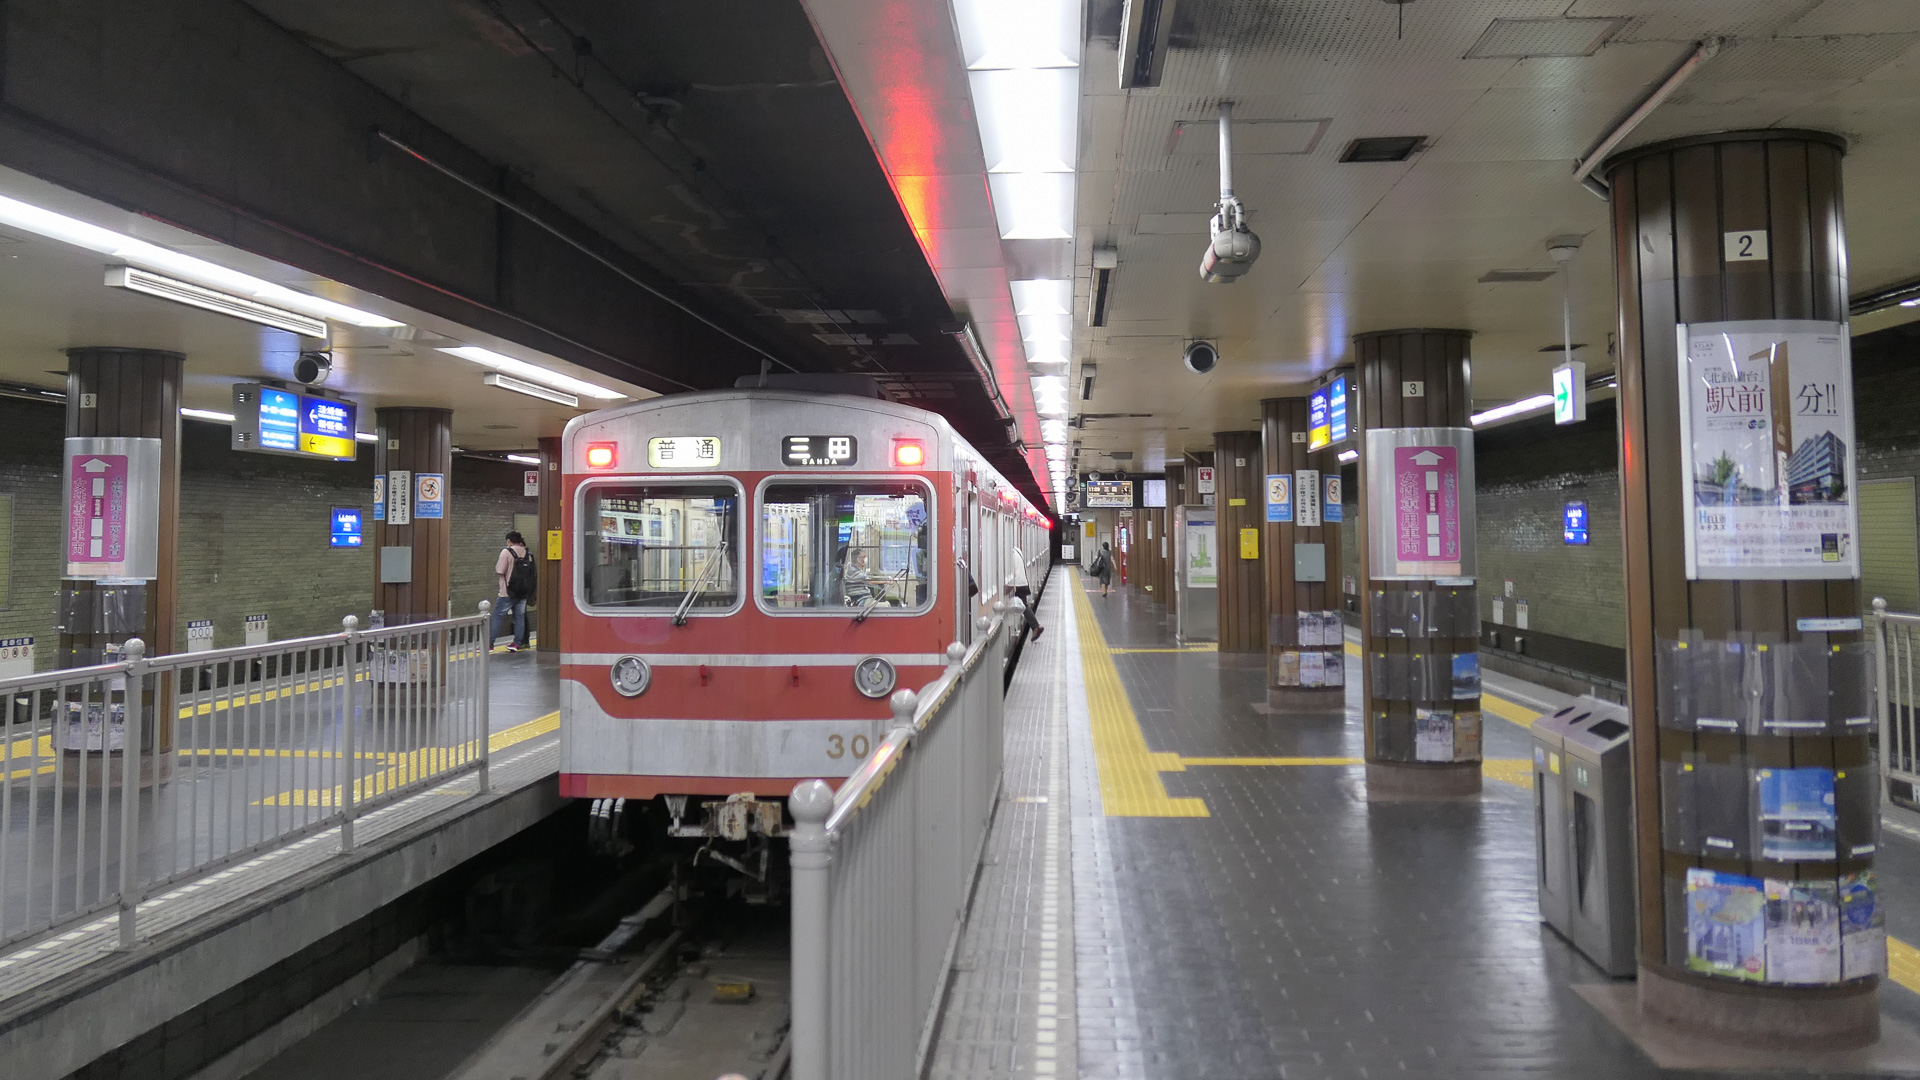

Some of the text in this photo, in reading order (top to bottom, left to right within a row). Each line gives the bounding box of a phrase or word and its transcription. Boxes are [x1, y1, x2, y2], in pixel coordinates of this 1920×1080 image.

[1739, 235, 1752, 256] 2
[1410, 383, 1416, 395] 3
[1706, 384, 1765, 414] 駅前
[85, 395, 90, 406] 3
[658, 439, 714, 460] 普通
[788, 437, 850, 459] 三田
[72, 477, 87, 556] 女性専用車両
[1399, 471, 1420, 554] 女性専用車両
[826, 733, 886, 759] 30
